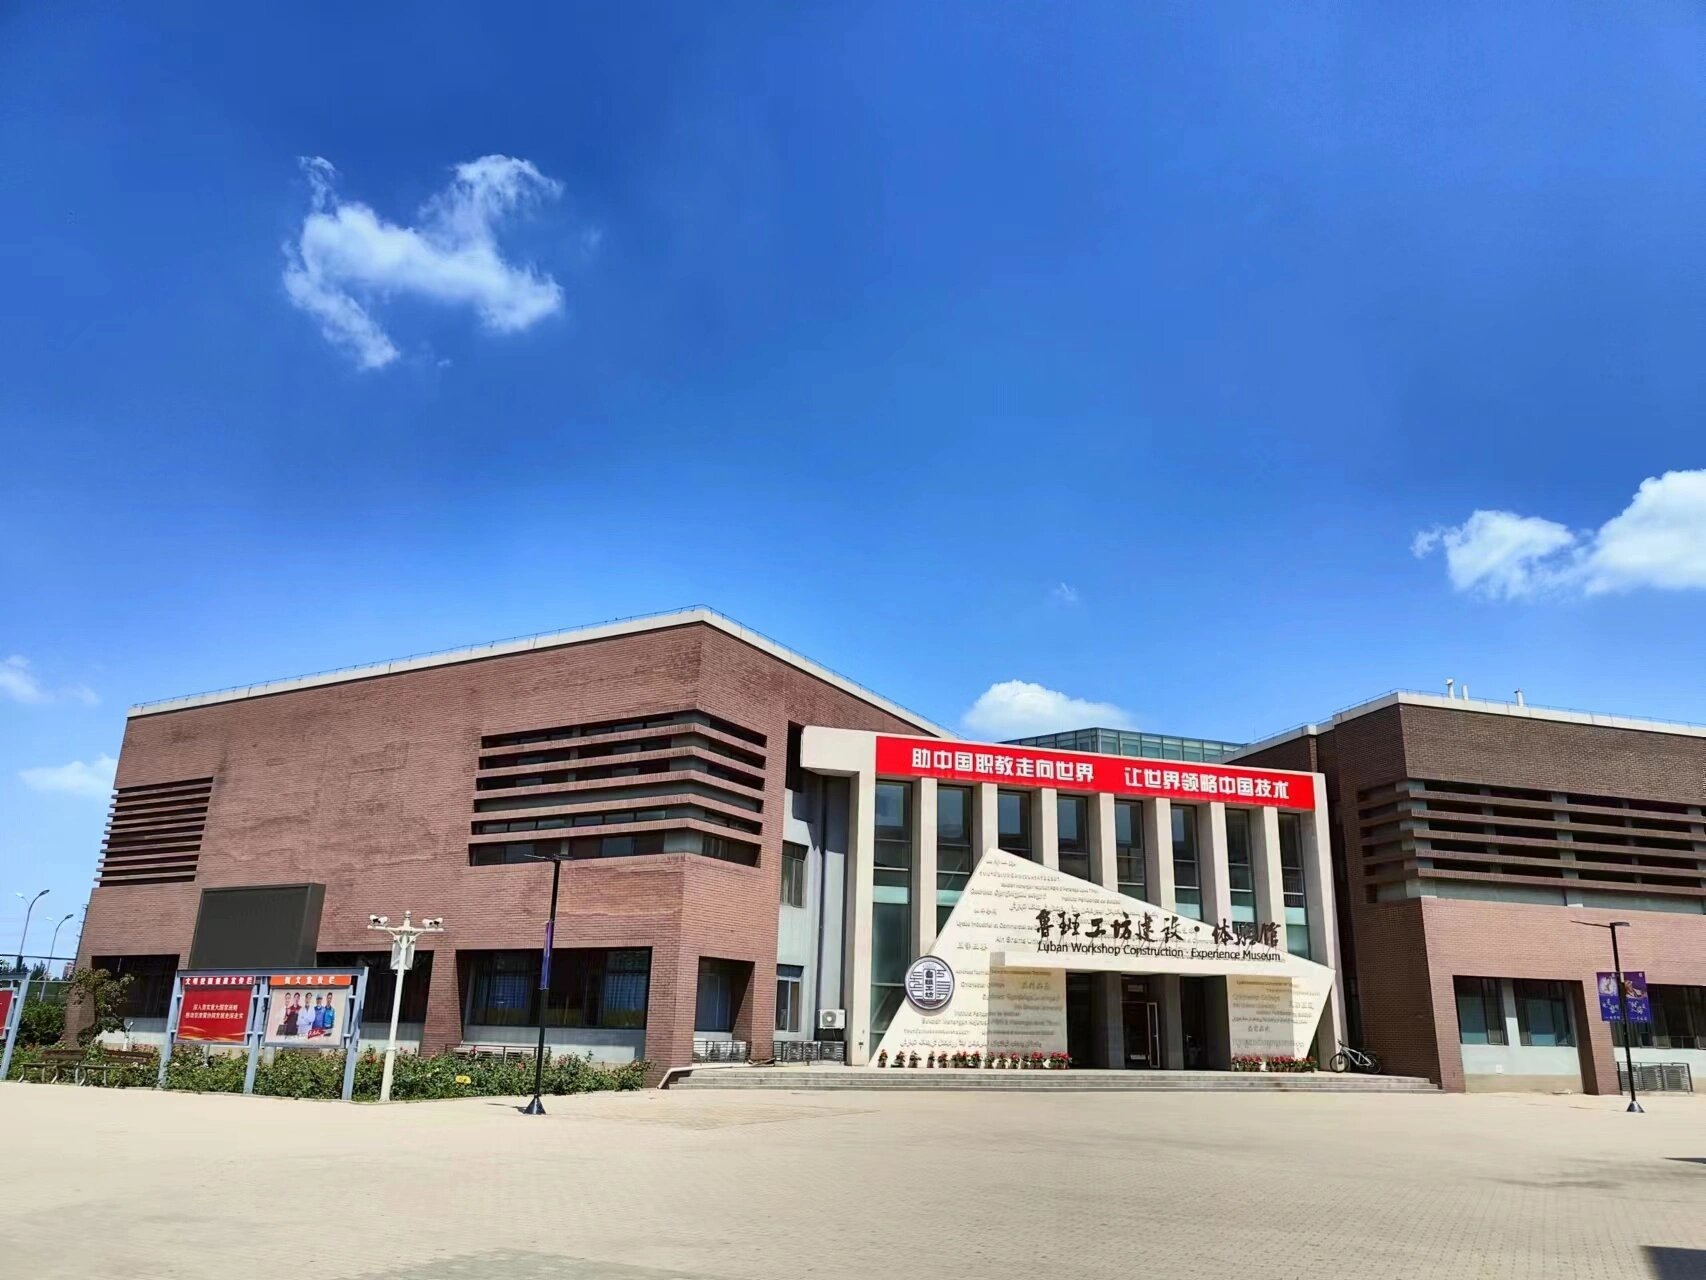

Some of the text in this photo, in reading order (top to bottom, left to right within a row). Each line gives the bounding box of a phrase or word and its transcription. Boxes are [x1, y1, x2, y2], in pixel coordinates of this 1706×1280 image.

[911, 747, 1290, 800] 助中国职教走向世界 让世界领略中国技术
[1038, 940, 1068, 953] Luban
[1071, 942, 1120, 955] Workshop
[1123, 944, 1184, 957] Construction
[1191, 947, 1240, 960] Experience
[1242, 950, 1281, 961] Museum
